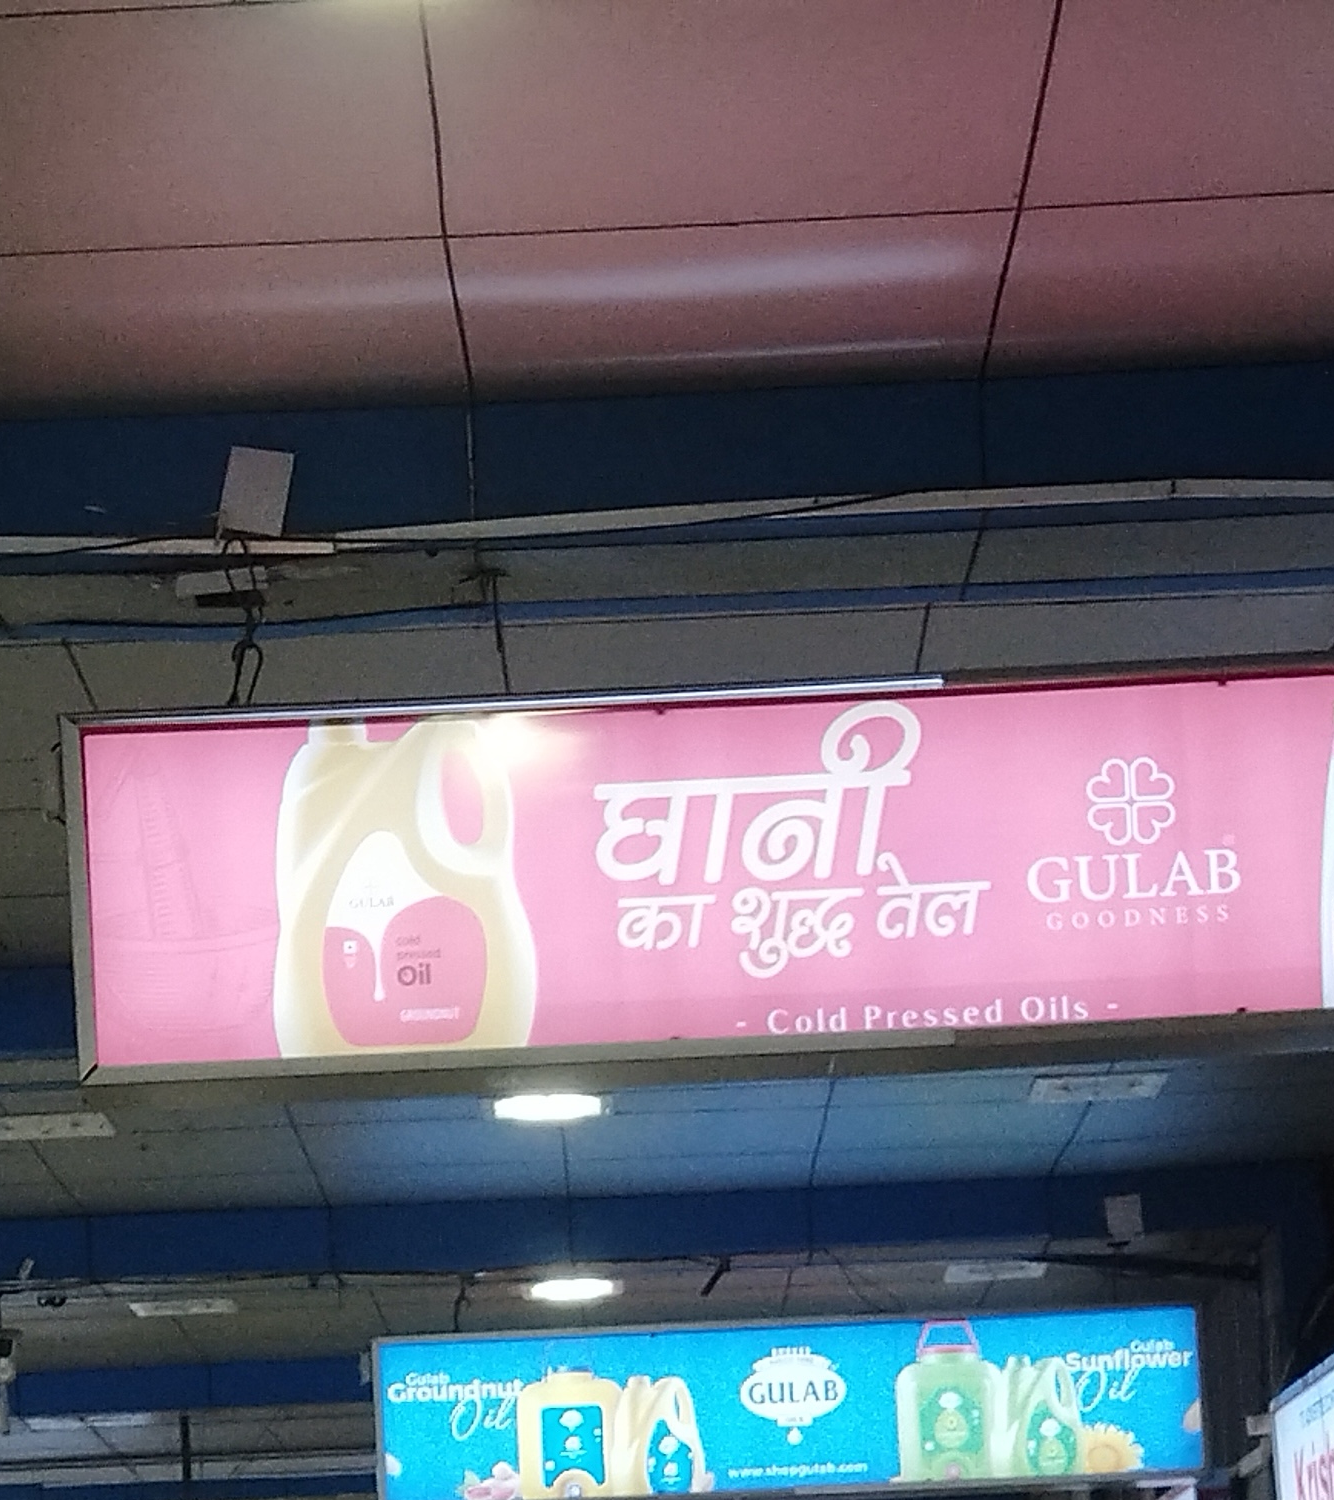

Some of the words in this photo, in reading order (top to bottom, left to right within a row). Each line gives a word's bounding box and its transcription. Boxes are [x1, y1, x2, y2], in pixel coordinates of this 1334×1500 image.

[594, 701, 921, 886] घानी
[1027, 848, 1242, 904] GULAB
[617, 894, 716, 950] का
[876, 852, 991, 939] तेल
[1047, 905, 1230, 931] GOODNESS
[397, 963, 431, 986] Oil
[768, 1007, 847, 1034] Cold
[865, 998, 1002, 1031] Pressed
[1021, 995, 1089, 1021] Oils
[1065, 1347, 1193, 1371] Sunflower
[387, 1378, 524, 1403] Groundnut
[749, 1380, 838, 1404] GULAB
[1076, 1367, 1147, 1412] Oil
[450, 1394, 515, 1440] Oil
